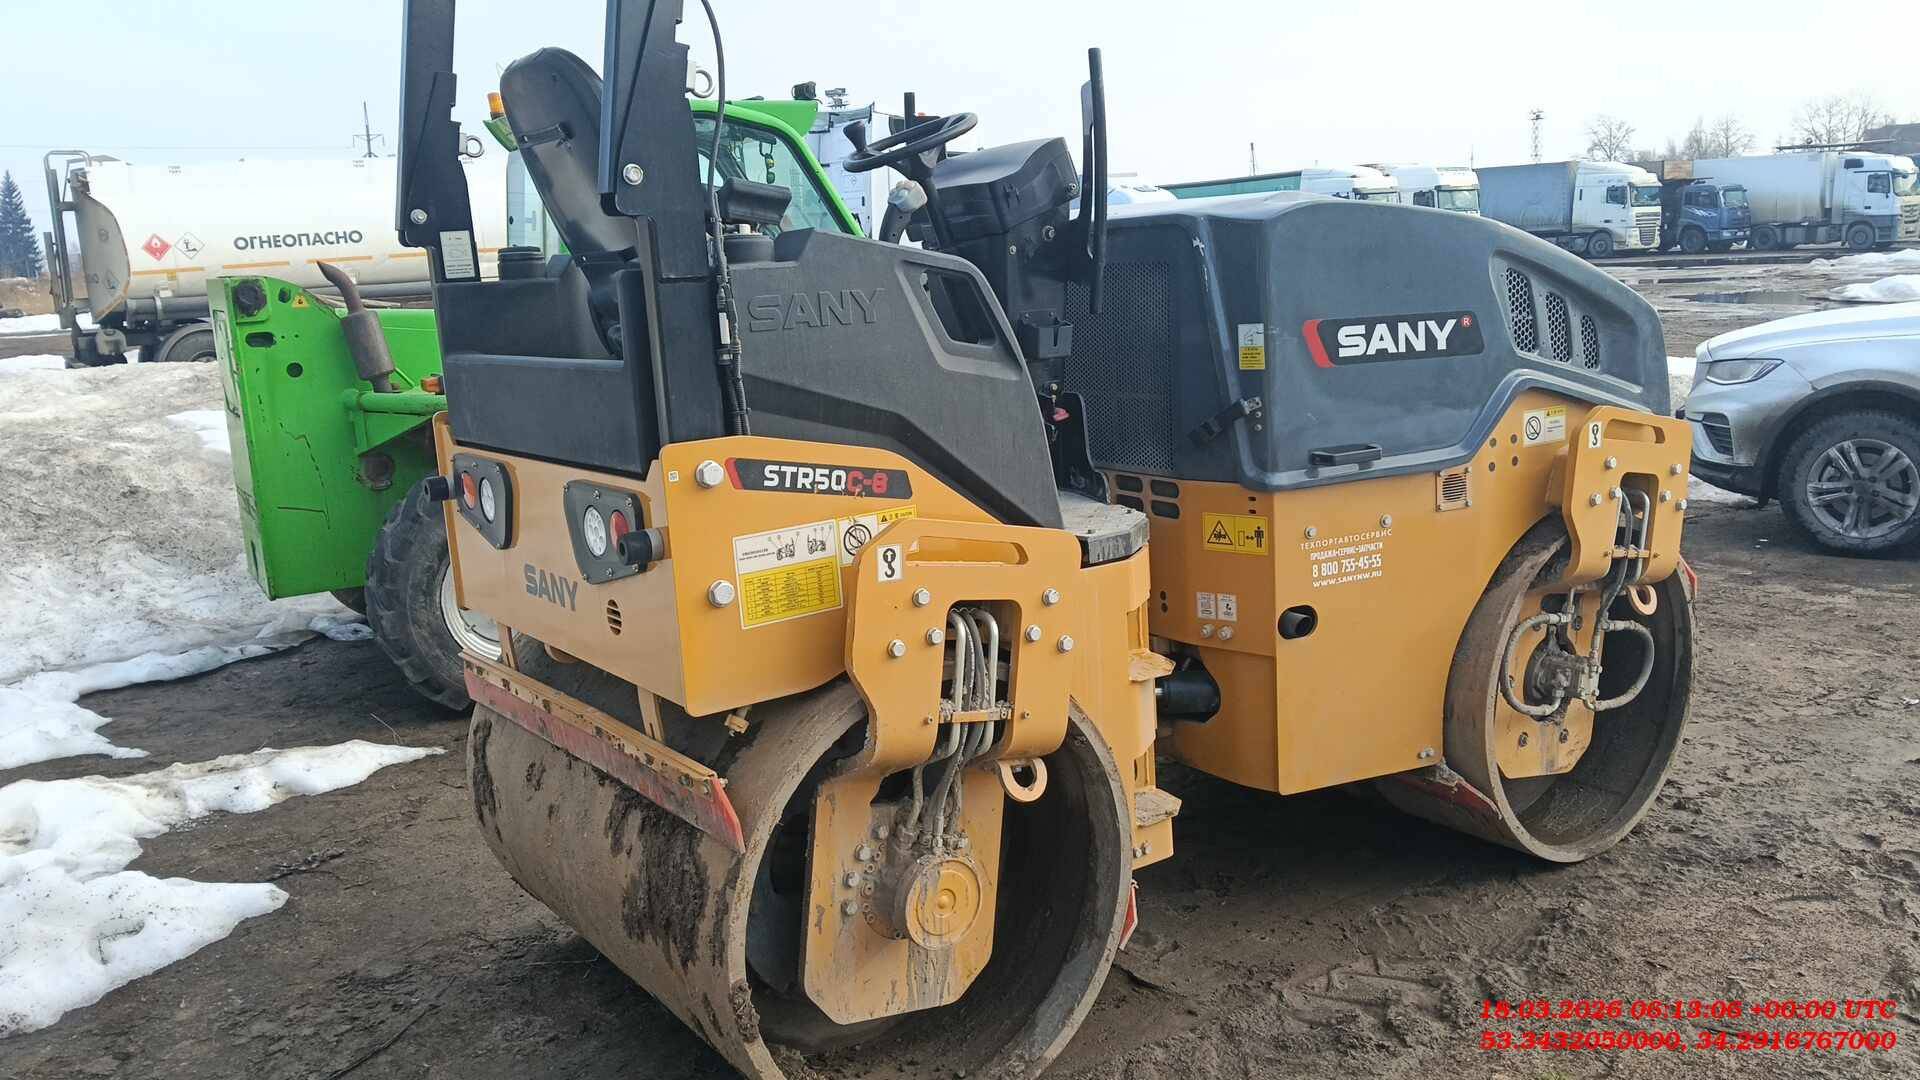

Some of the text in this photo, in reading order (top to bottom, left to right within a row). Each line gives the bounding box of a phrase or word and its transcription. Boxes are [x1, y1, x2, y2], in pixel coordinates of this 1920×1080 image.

[233, 229, 363, 250] ОГНЕОПАСНО
[748, 288, 886, 332] SANY
[1337, 318, 1457, 358] SANY
[763, 464, 889, 494] STR50C-8
[1300, 529, 1393, 550] ТЕХПОРТАВТОСЕРВИС
[1312, 553, 1382, 578] 8 800 755-45-55
[524, 563, 578, 612] SANY
